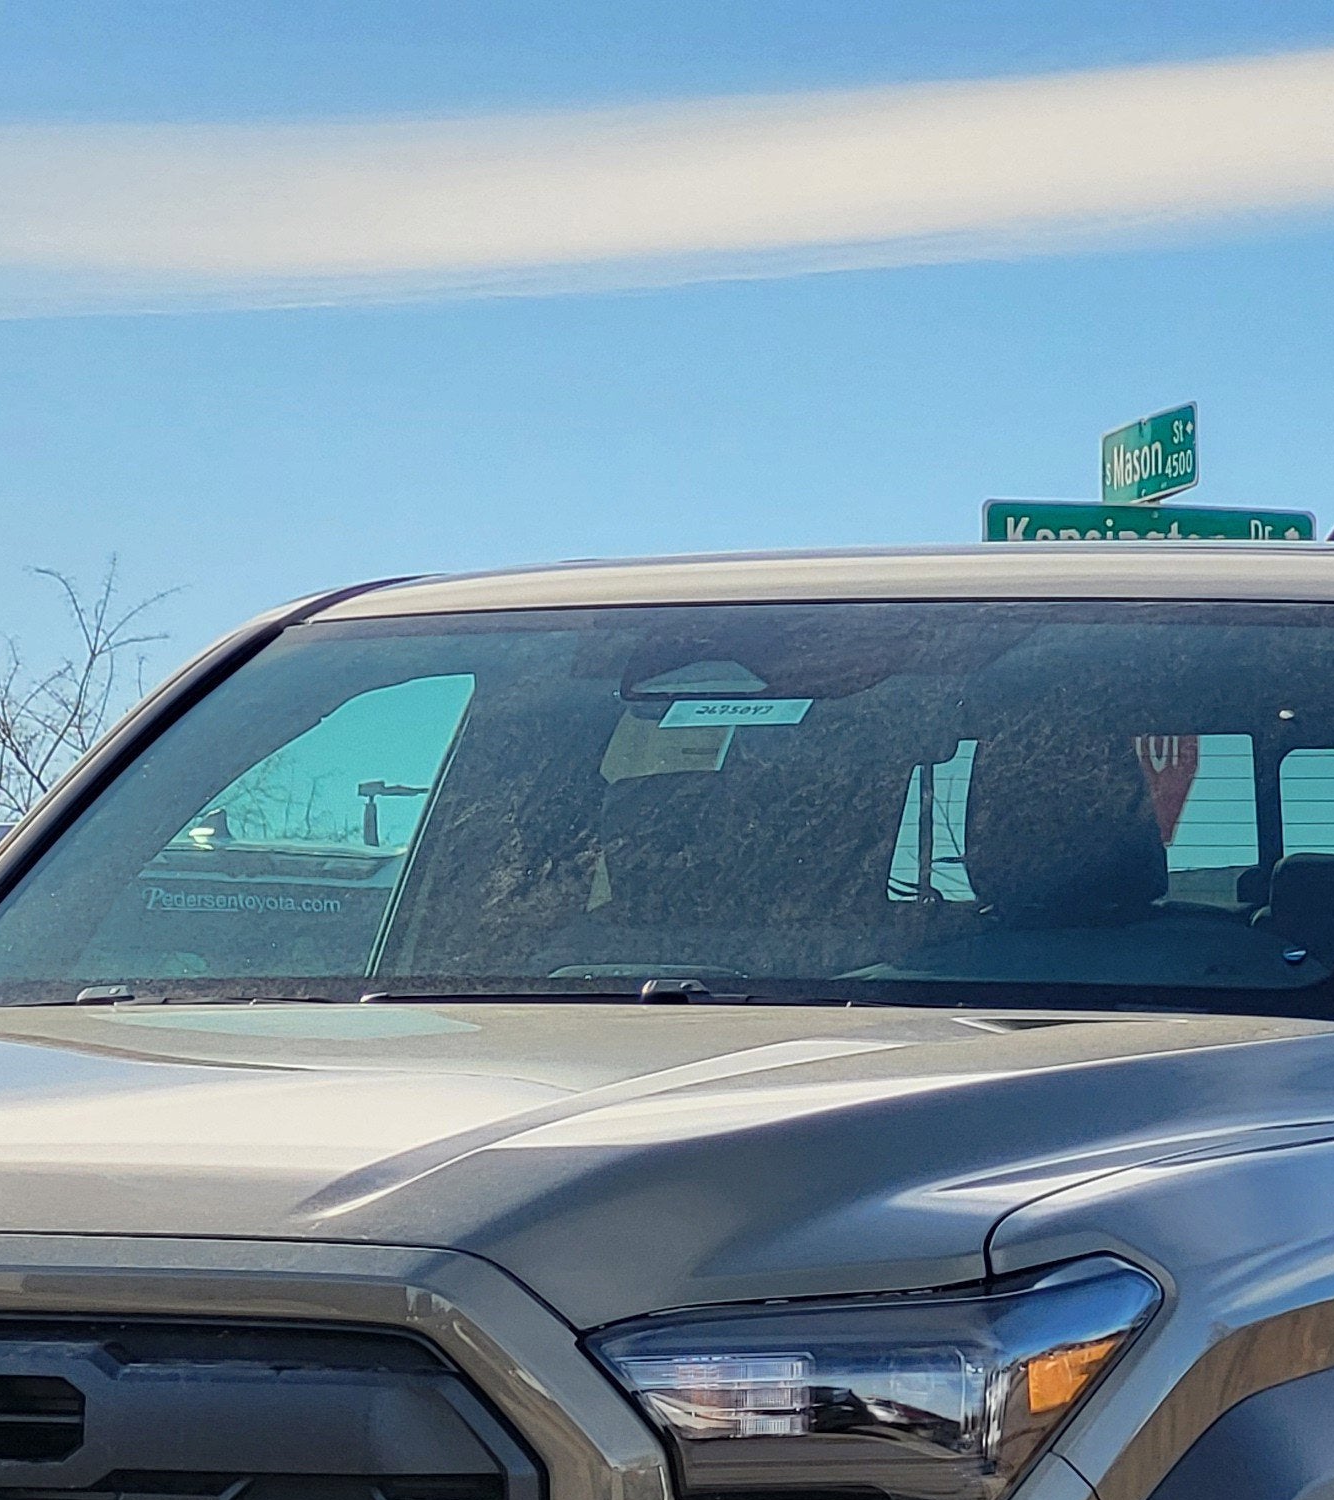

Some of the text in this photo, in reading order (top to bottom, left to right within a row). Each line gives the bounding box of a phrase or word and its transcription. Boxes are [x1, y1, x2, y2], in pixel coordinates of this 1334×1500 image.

[1113, 441, 1163, 490] Mason
[1173, 420, 1184, 444] St
[1165, 449, 1193, 478] 4500
